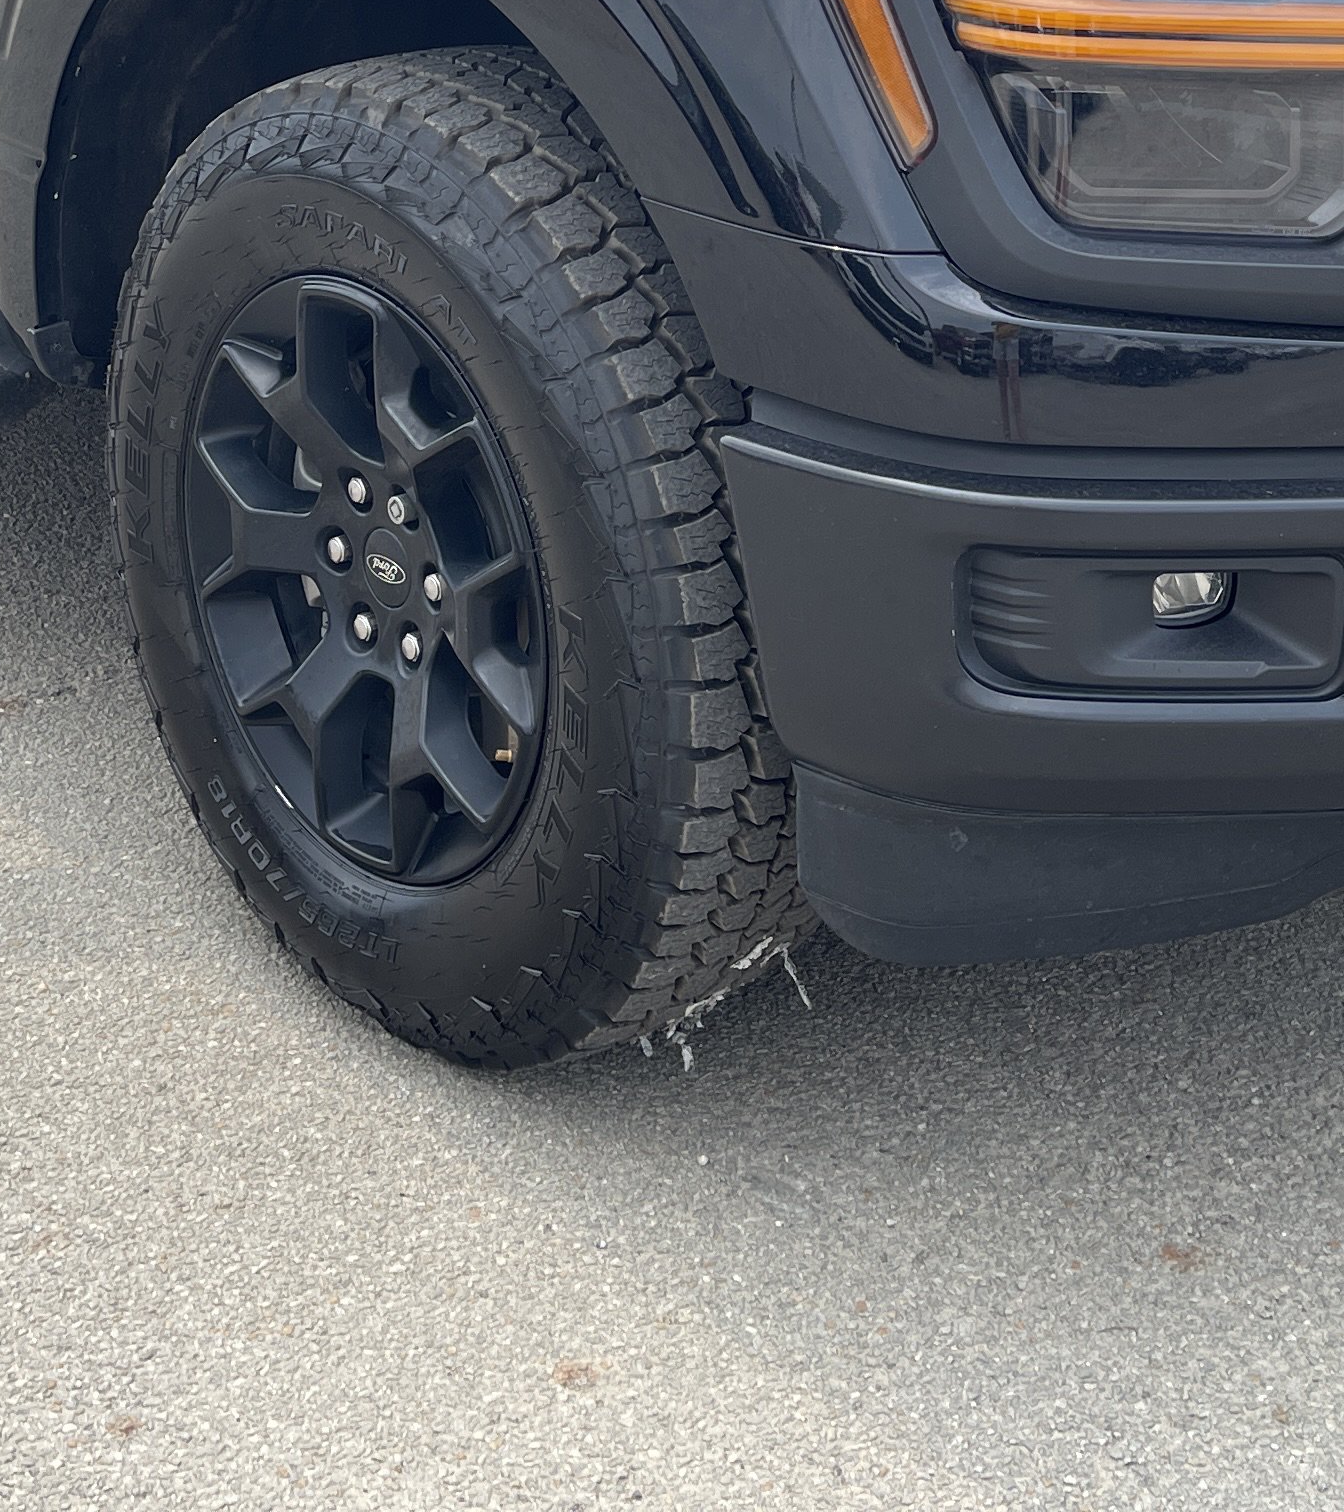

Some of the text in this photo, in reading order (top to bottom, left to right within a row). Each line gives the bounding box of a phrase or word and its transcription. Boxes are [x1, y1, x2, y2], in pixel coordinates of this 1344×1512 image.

[274, 202, 409, 276] SAFARI
[124, 296, 172, 565] KELLY
[372, 557, 398, 581] Ford
[533, 603, 590, 910] KELLY
